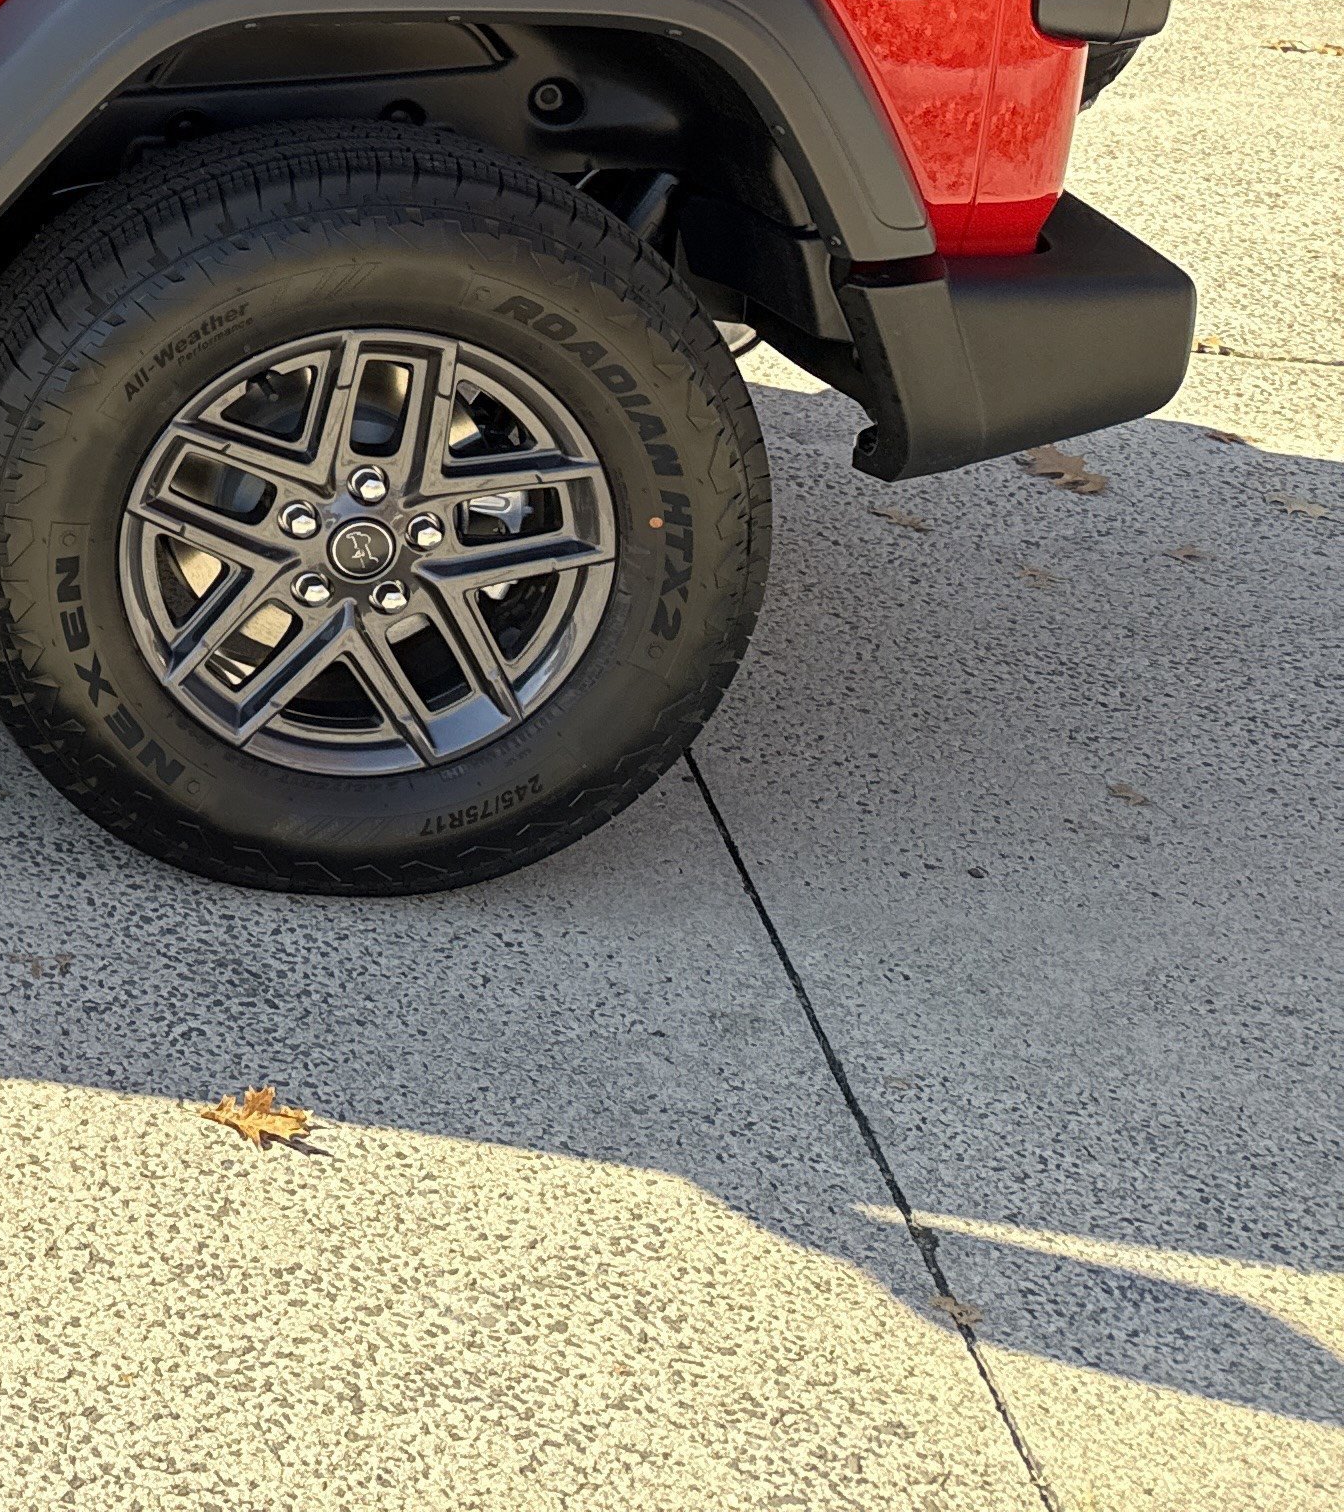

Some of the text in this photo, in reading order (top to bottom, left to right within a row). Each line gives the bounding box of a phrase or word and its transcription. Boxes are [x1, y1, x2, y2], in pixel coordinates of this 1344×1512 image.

[124, 302, 249, 402] All-Weather
[493, 295, 694, 641] ROADIAN HTX2
[55, 555, 186, 785] NEXEN
[419, 773, 544, 837] 245/75R17
